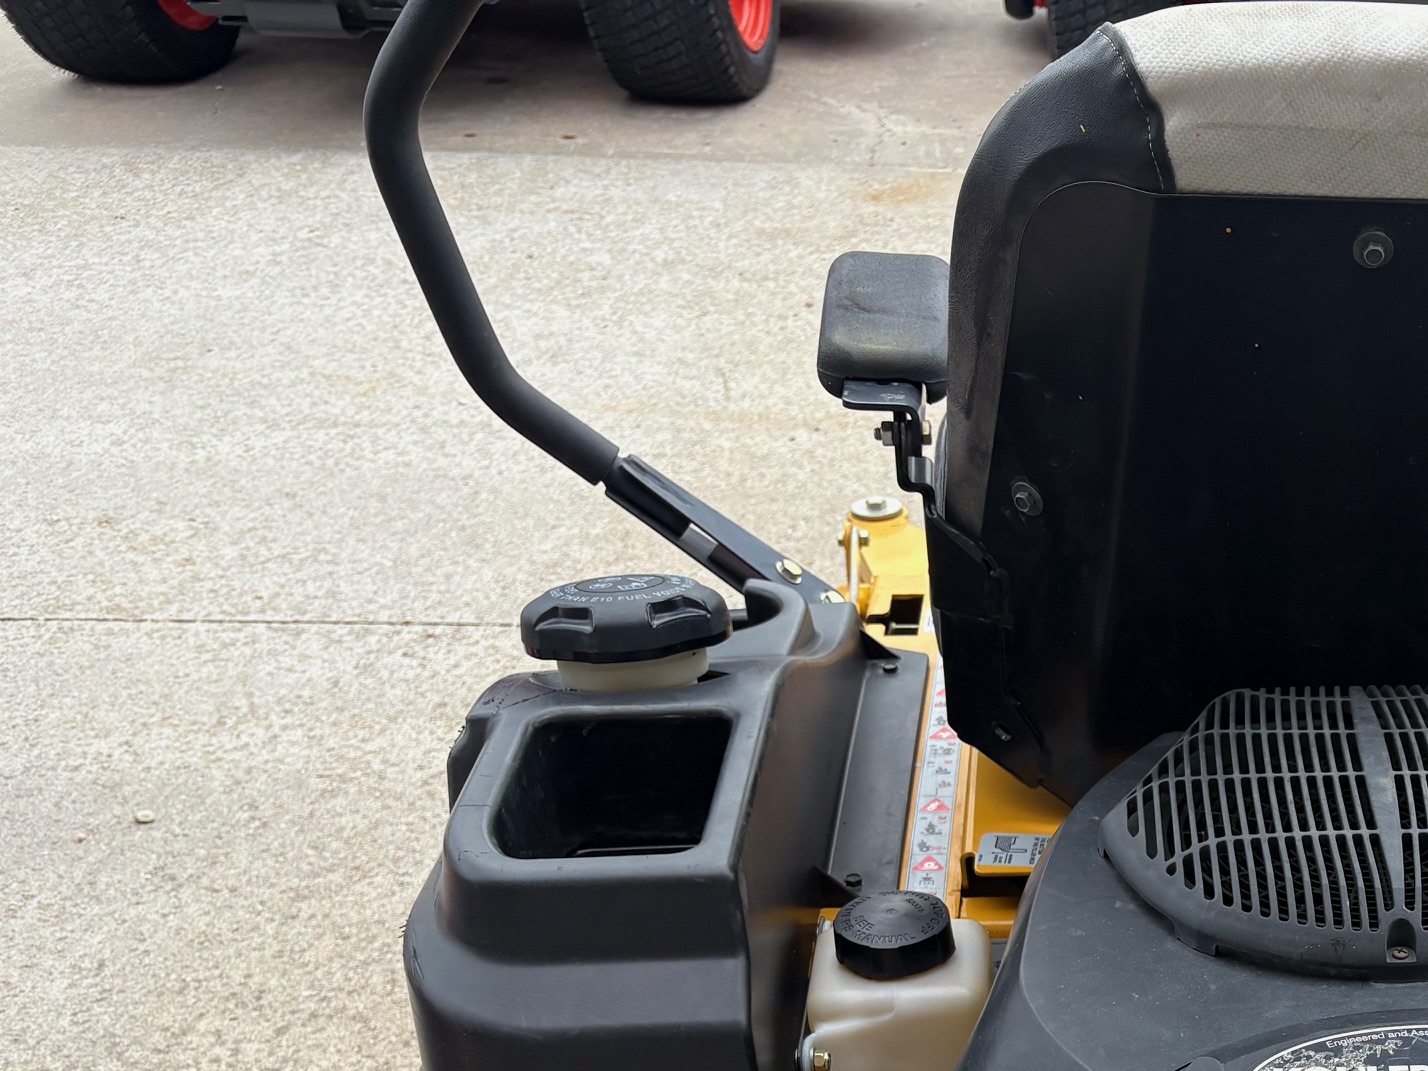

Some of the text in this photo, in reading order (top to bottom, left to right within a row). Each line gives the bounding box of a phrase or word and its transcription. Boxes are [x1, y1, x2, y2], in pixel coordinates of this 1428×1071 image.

[617, 593, 651, 601] FUEL
[854, 915, 875, 932] SEE
[853, 929, 916, 944] MANUAL
[1326, 1032, 1386, 1048] Engineered
[1388, 1030, 1408, 1038] and
